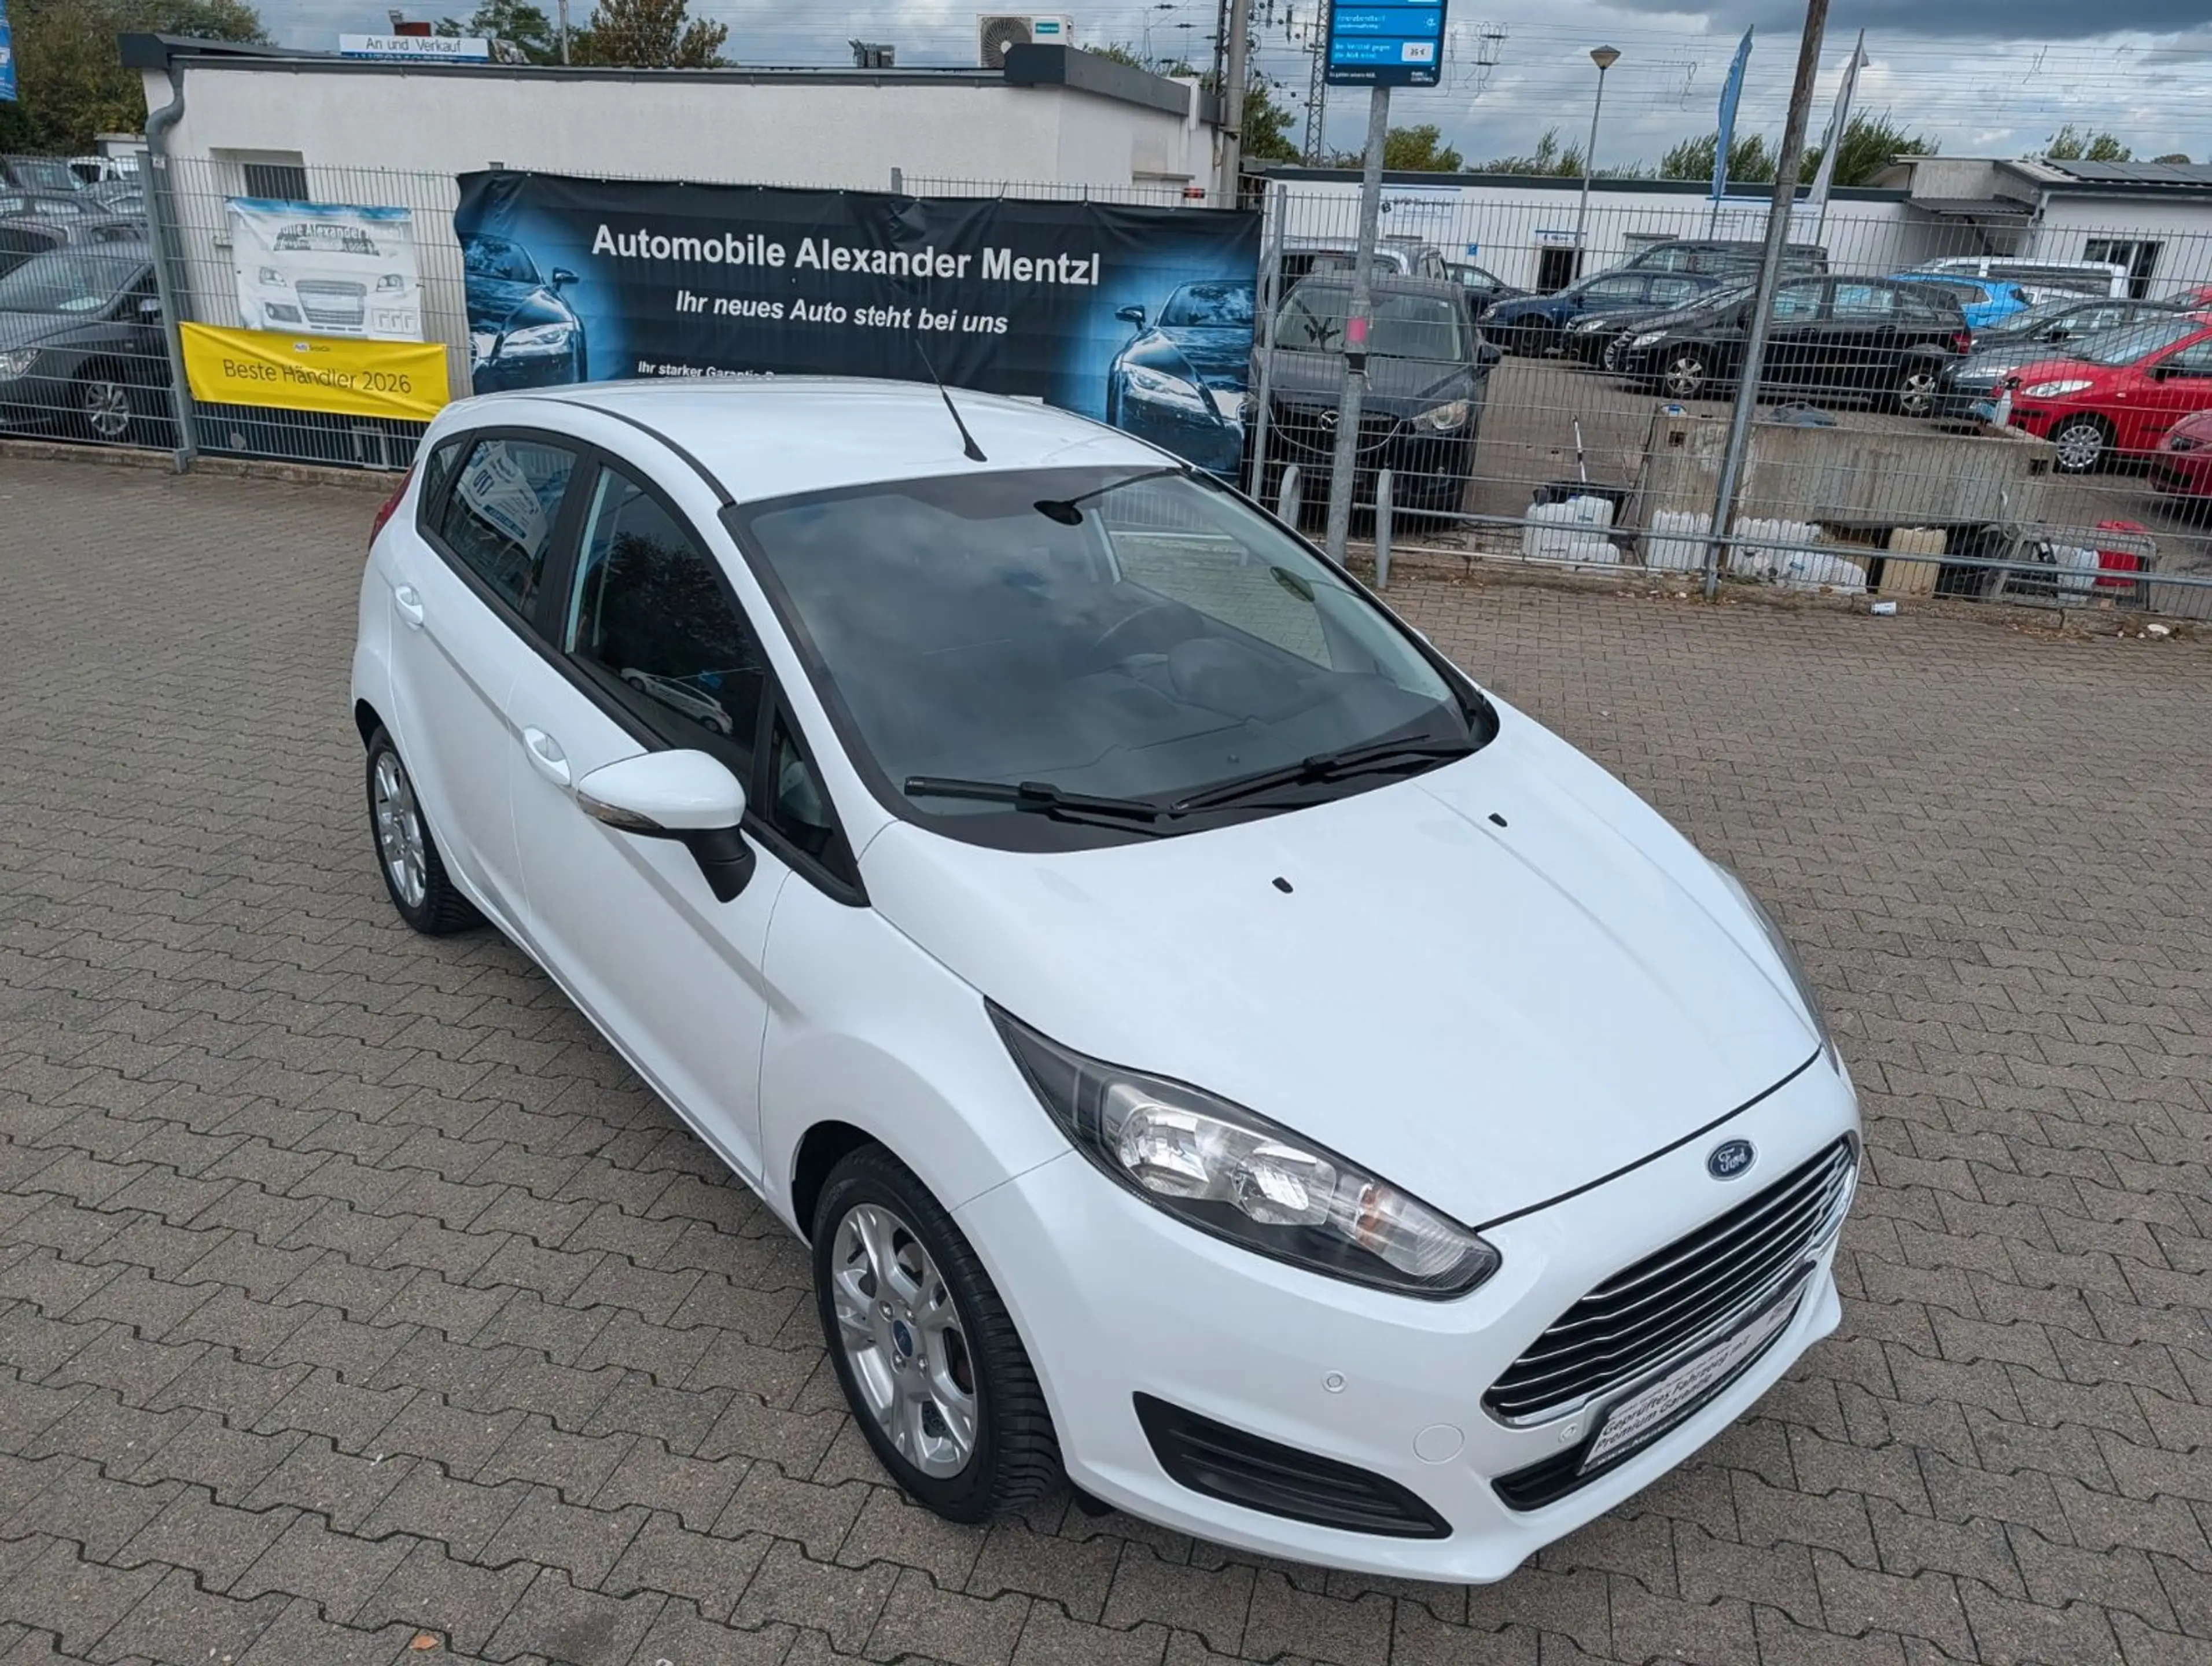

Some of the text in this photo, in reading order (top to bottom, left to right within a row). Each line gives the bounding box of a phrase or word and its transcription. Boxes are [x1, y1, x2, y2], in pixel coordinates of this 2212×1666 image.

[366, 37, 462, 53] An und Verkauf
[592, 223, 1099, 286] Automobile Alexander Mentzl
[676, 290, 1009, 334] Ihr neues Auto steht bei uns
[223, 359, 412, 394] Beste Händler 2026
[638, 361, 656, 374] Ihr
[658, 364, 704, 377] starker
[1718, 1147, 1747, 1173] Ford
[1595, 1410, 1657, 1452] Premium
